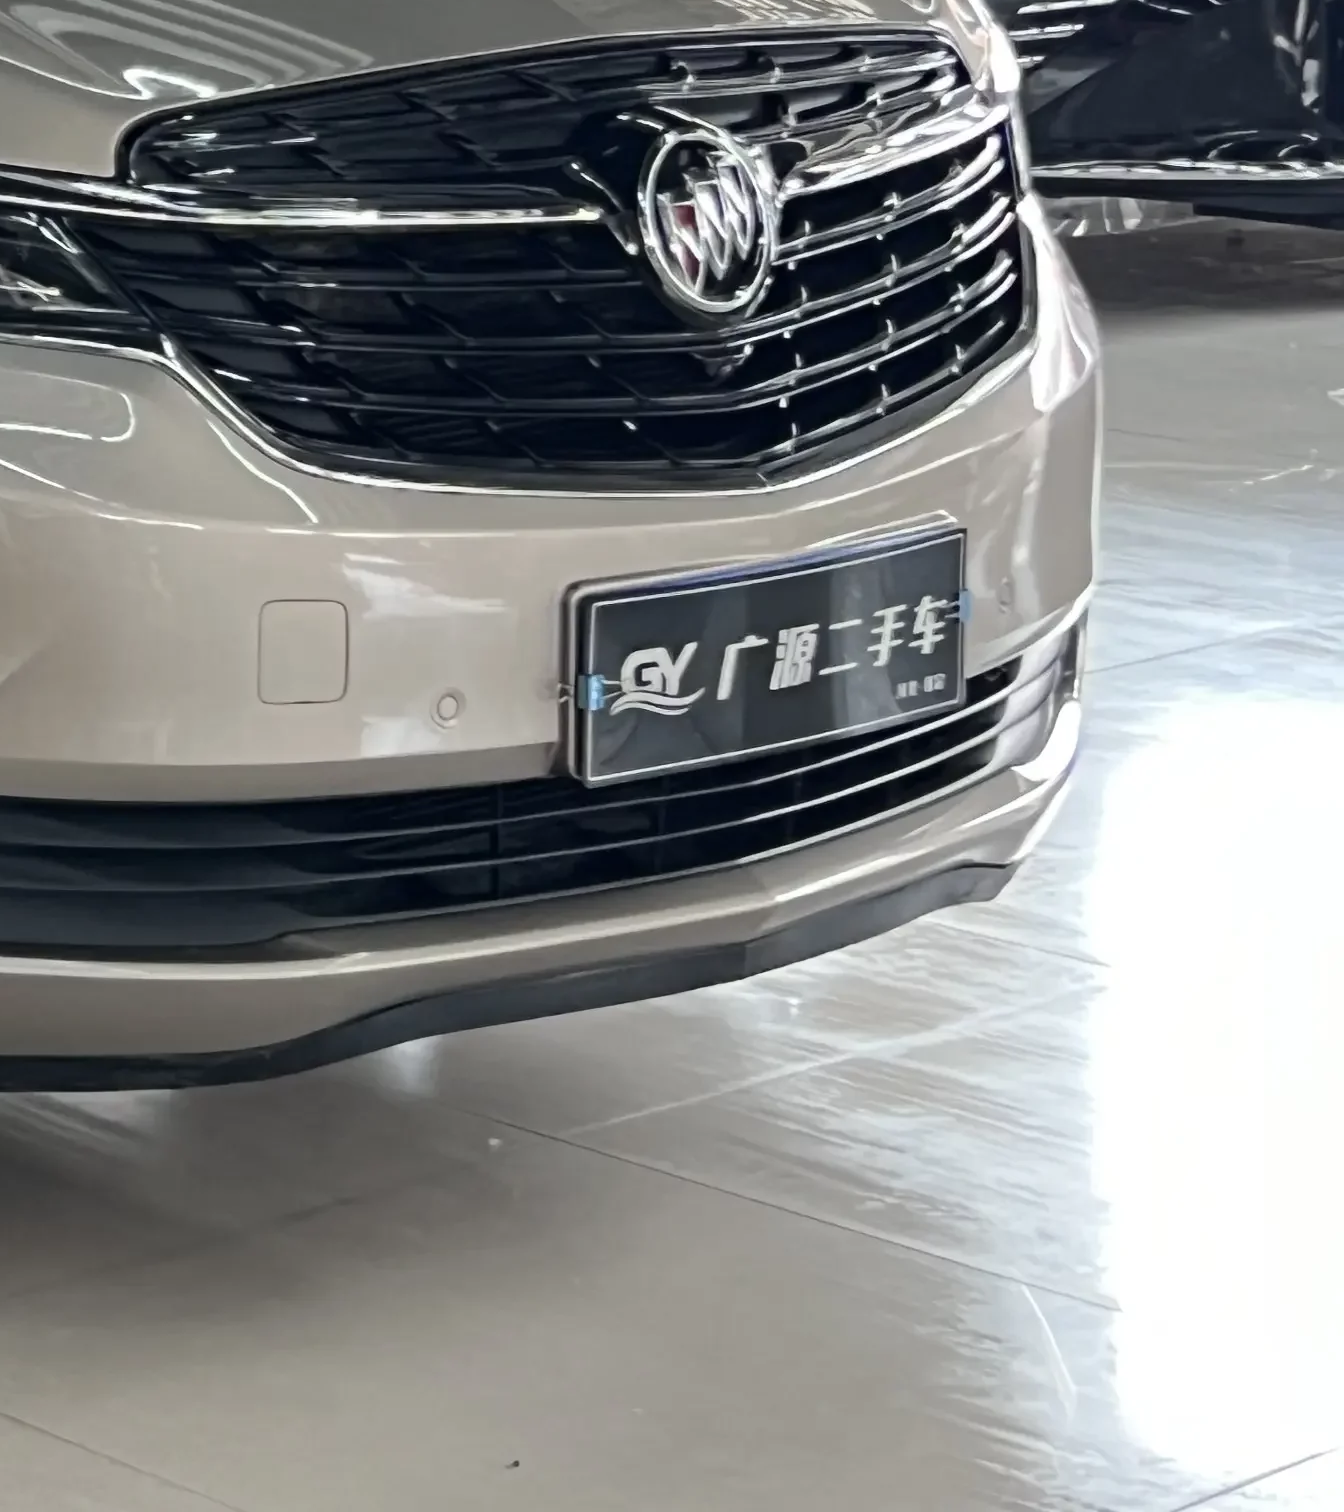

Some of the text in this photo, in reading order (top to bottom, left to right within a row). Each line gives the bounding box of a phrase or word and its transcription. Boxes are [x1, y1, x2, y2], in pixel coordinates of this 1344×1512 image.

[716, 595, 949, 701] 广源二手车
